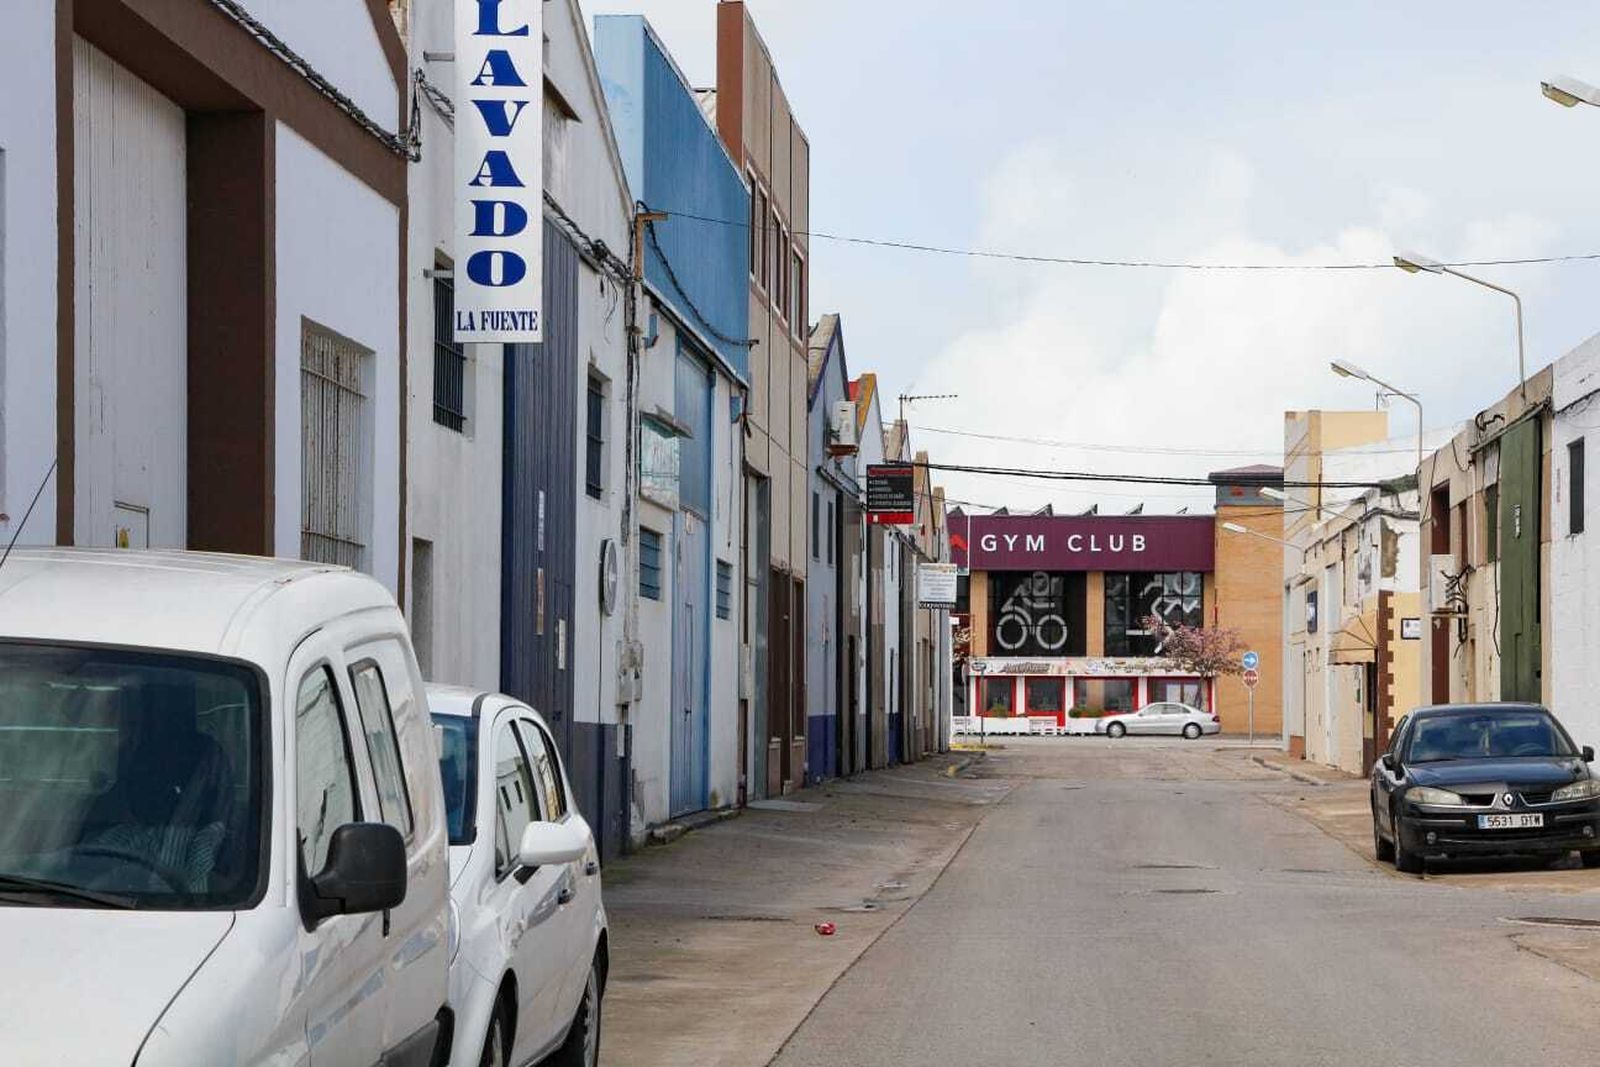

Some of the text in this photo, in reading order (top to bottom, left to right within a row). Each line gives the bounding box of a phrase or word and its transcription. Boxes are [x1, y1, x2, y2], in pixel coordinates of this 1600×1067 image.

[466, 0, 529, 287] LAVADO
[457, 311, 538, 331] LA FUENTE
[980, 534, 1147, 552] GYM CLUB
[1487, 815, 1513, 827] 5531
